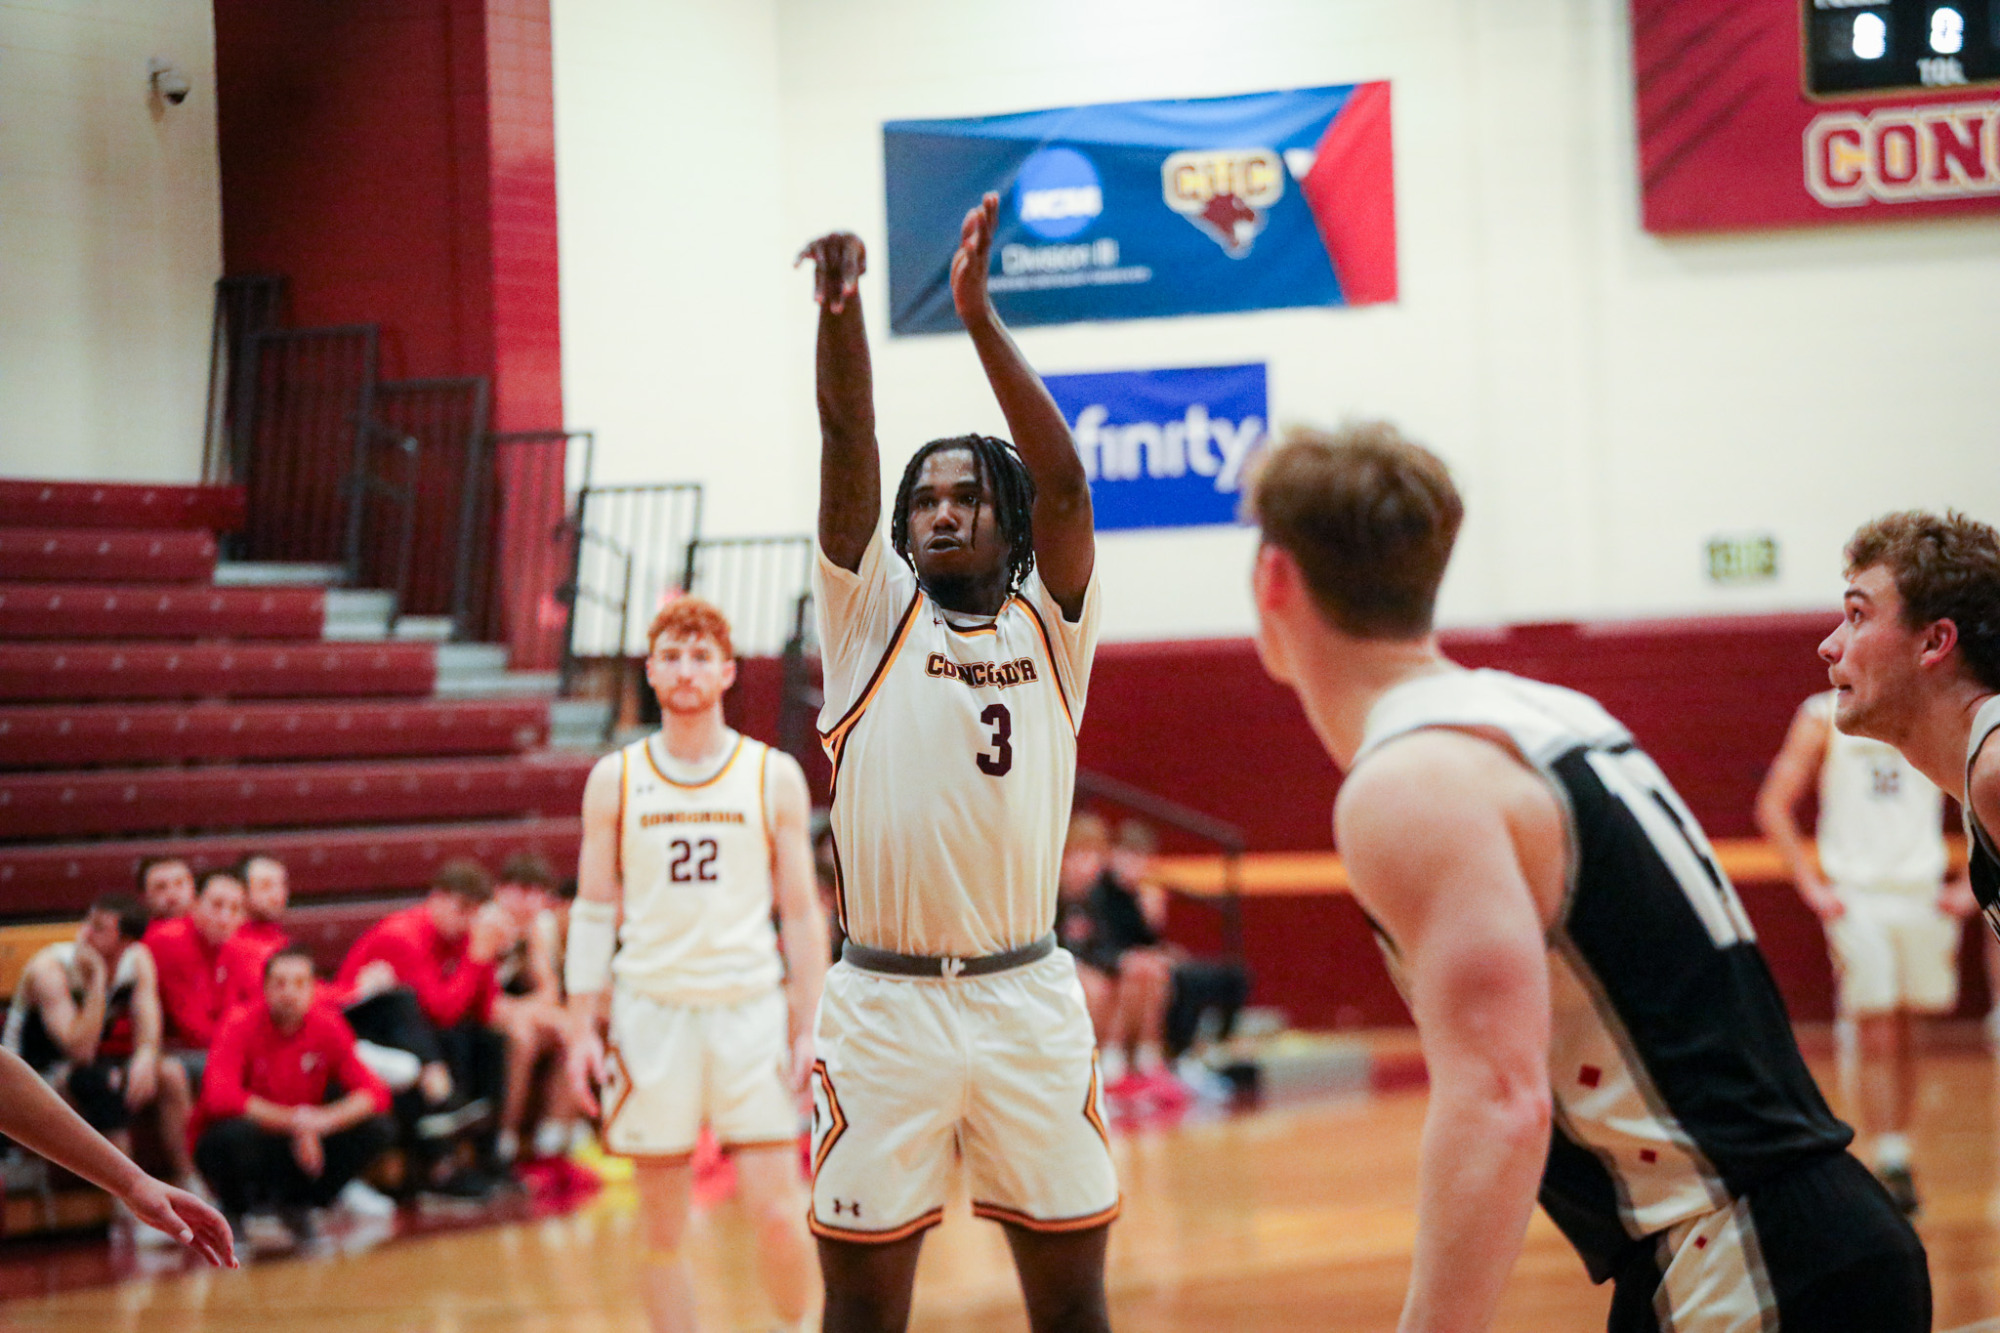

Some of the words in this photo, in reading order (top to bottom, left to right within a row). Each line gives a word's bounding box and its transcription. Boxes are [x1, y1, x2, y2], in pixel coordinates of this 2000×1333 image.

[1804, 104, 2000, 207] CON
[1075, 405, 1265, 492] finity
[976, 703, 1012, 777] 3
[669, 839, 718, 882] 22
